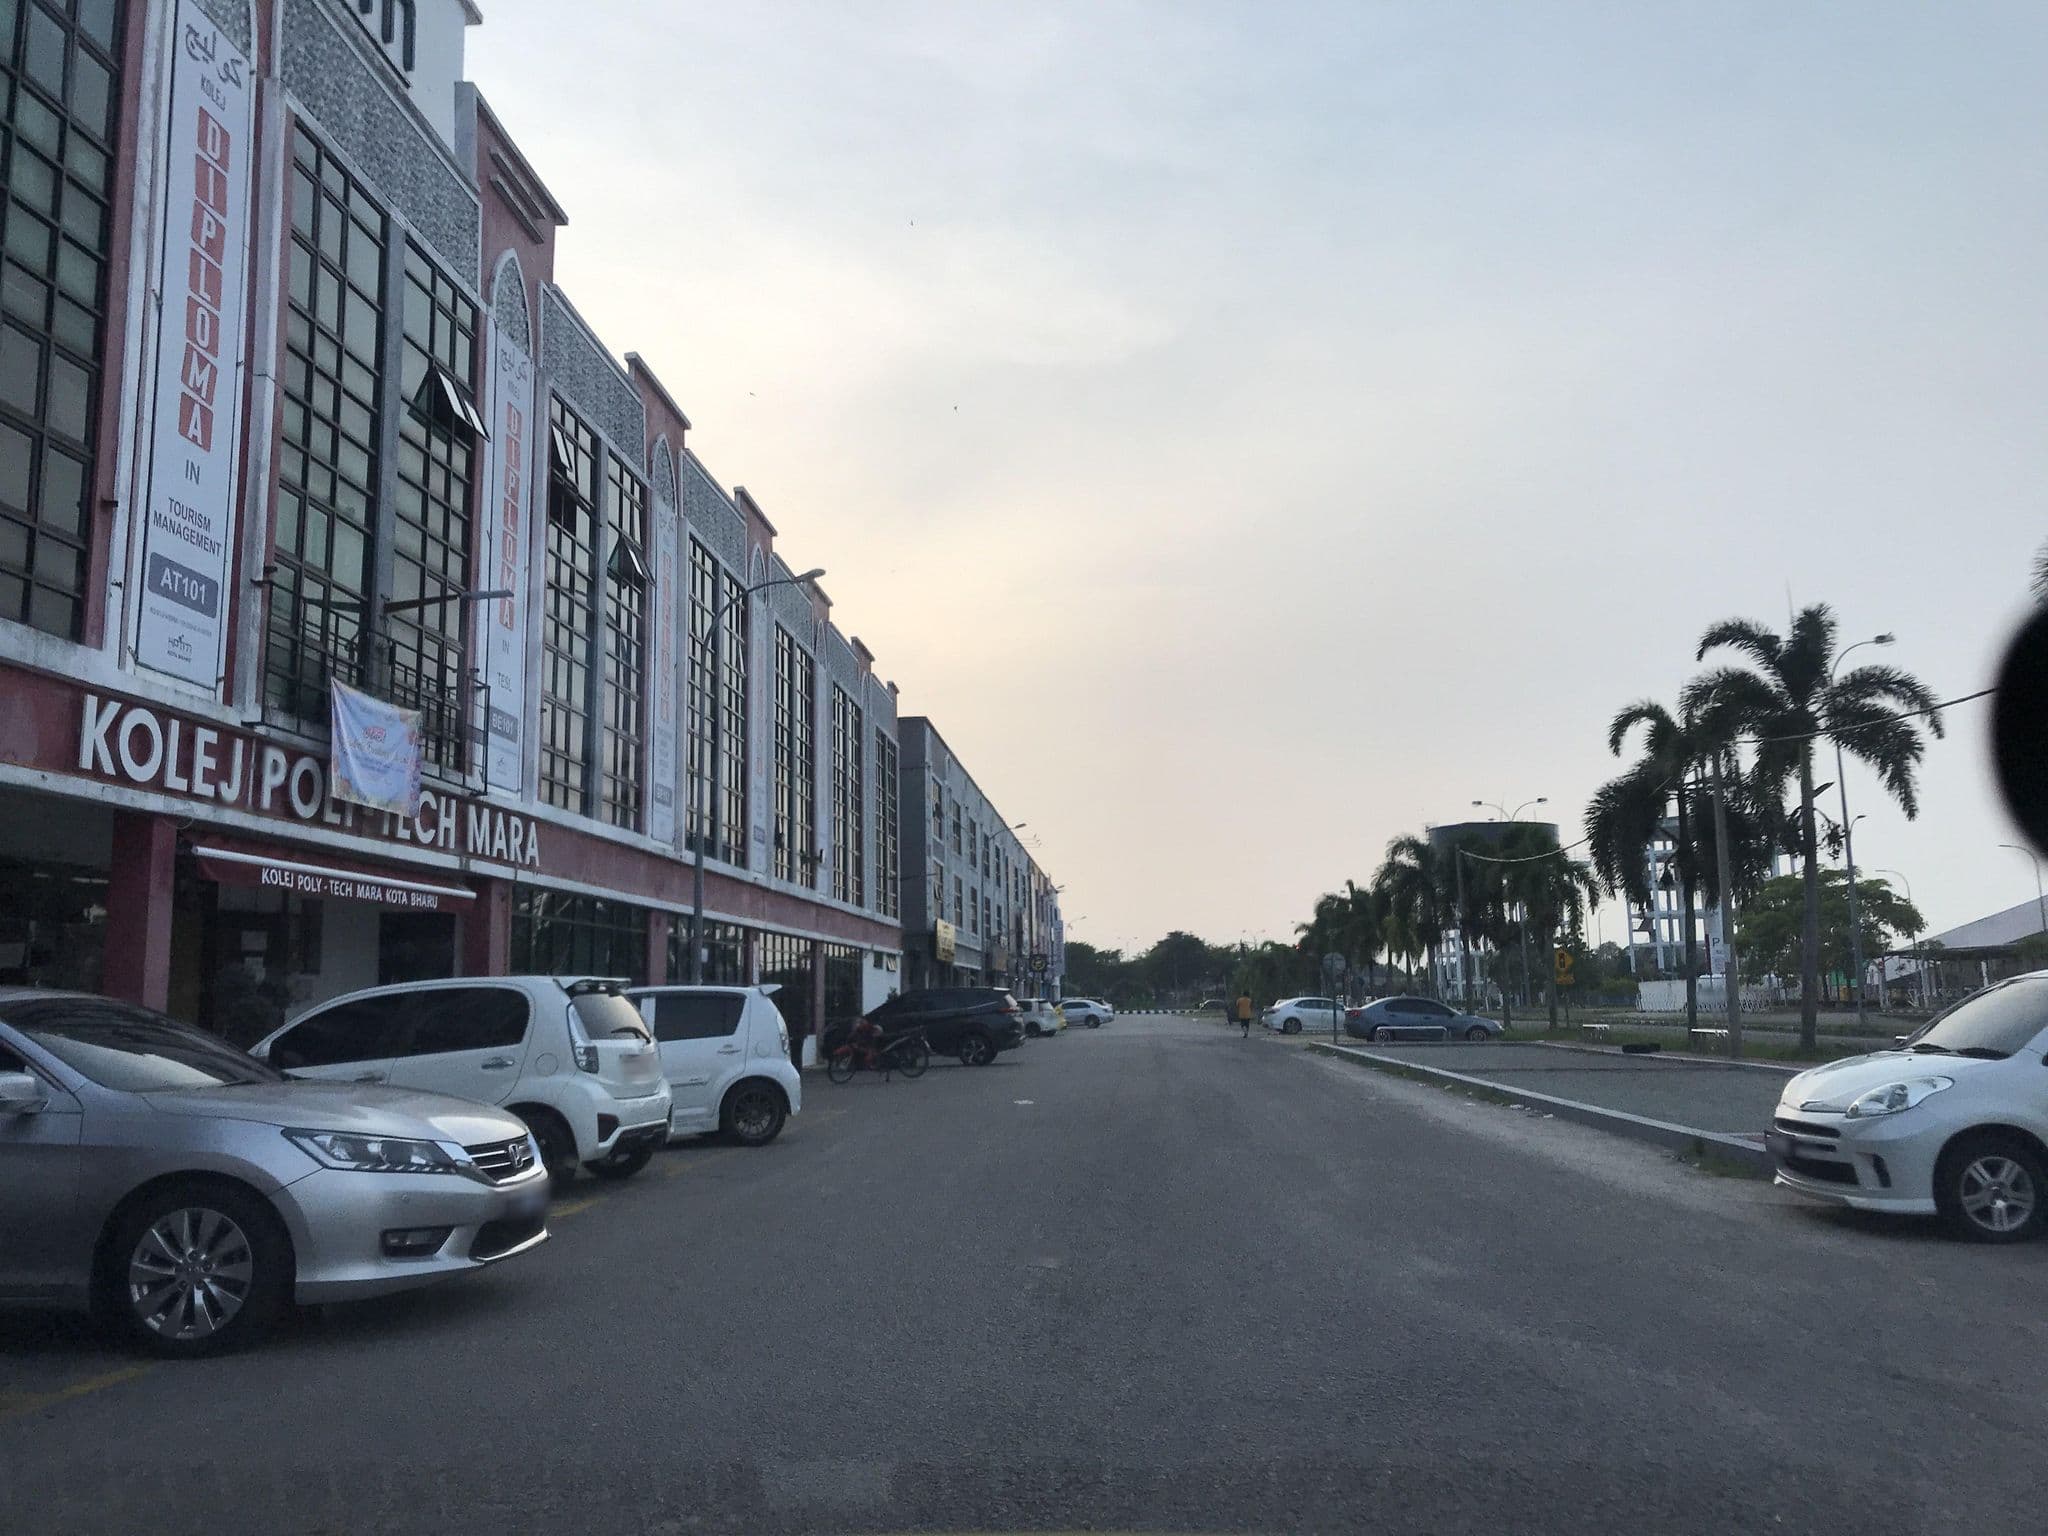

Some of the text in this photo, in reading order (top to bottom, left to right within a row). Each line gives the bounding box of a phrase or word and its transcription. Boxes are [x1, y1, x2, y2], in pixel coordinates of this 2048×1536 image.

[186, 124, 222, 448] DIPLOMA
[185, 459, 200, 485] IN
[153, 509, 222, 557] MANAGEMENT
[168, 496, 211, 534] TOURISM
[502, 406, 519, 629] DIPLOMA
[160, 567, 206, 605] AT101
[79, 694, 244, 804] KOLEJ
[467, 803, 540, 867] MARA
[261, 867, 294, 888] KOLEJ
[298, 875, 322, 893] POLY
[329, 880, 353, 898] TECH
[356, 884, 382, 902] MARA
[386, 889, 408, 905] KOTA
[410, 893, 438, 909] BHARU
